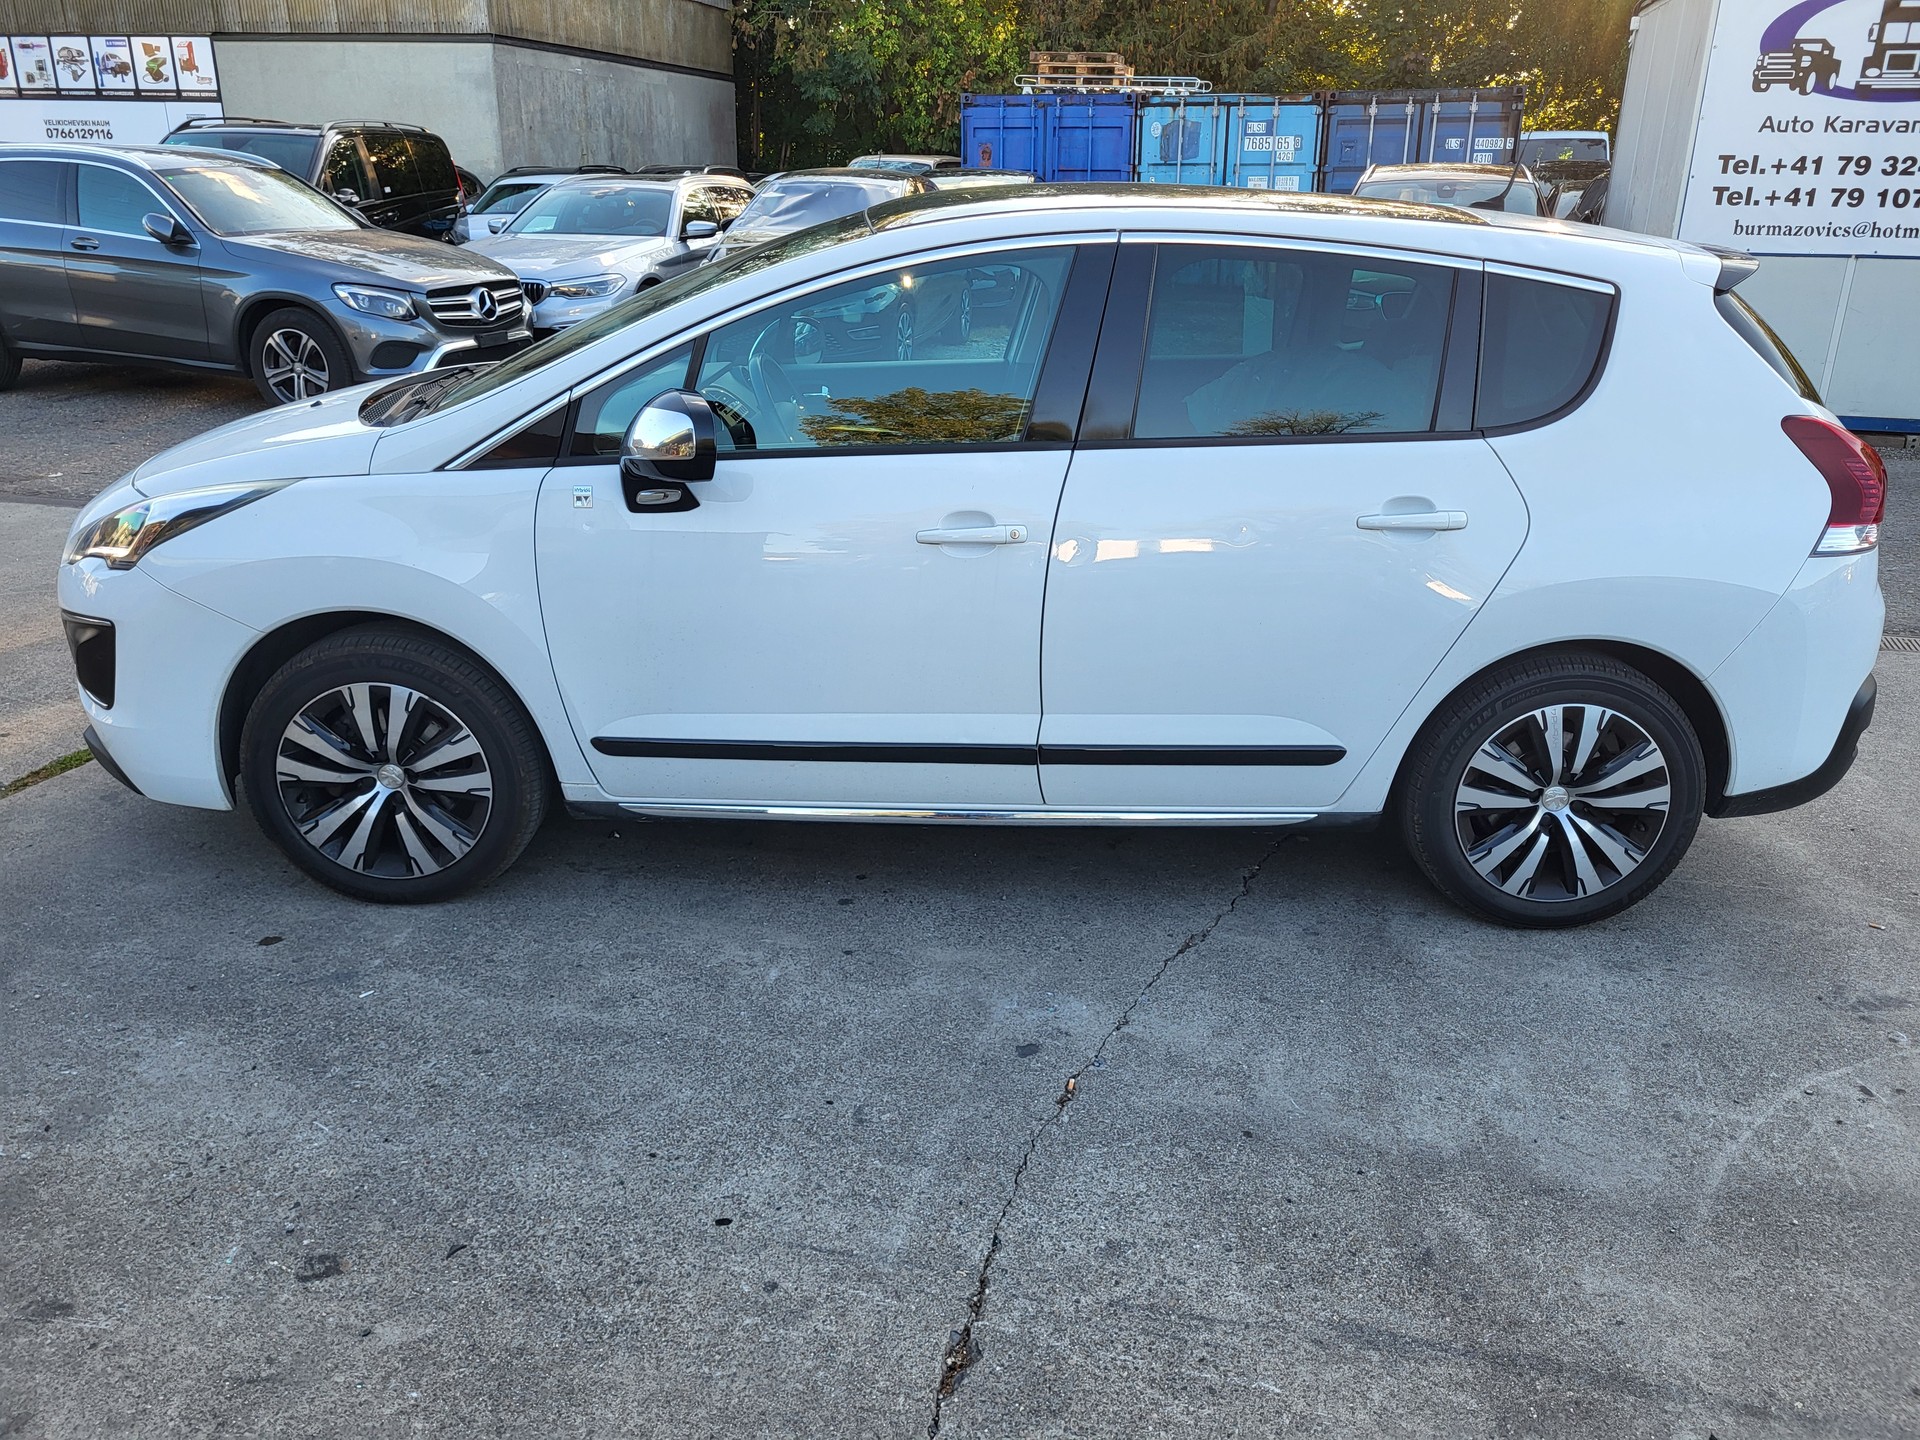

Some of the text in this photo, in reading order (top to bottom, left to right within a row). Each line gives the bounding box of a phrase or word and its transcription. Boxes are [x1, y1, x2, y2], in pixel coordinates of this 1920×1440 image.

[43, 119, 91, 127] VELIKICHEVSKI
[1247, 123, 1266, 132] HLSU
[1758, 116, 1920, 133] Auto Karavan
[46, 128, 113, 140] 0766129116
[1475, 139, 1504, 149] 440982
[1507, 138, 1514, 149] 5
[1276, 151, 1294, 161] 42G1
[1473, 153, 1492, 164] 4310
[1718, 155, 1920, 176] Tel.+41 79 32
[1712, 186, 1817, 207] Tel.+41
[1830, 187, 1865, 208] 79
[1439, 707, 1493, 774] MICHELIN
